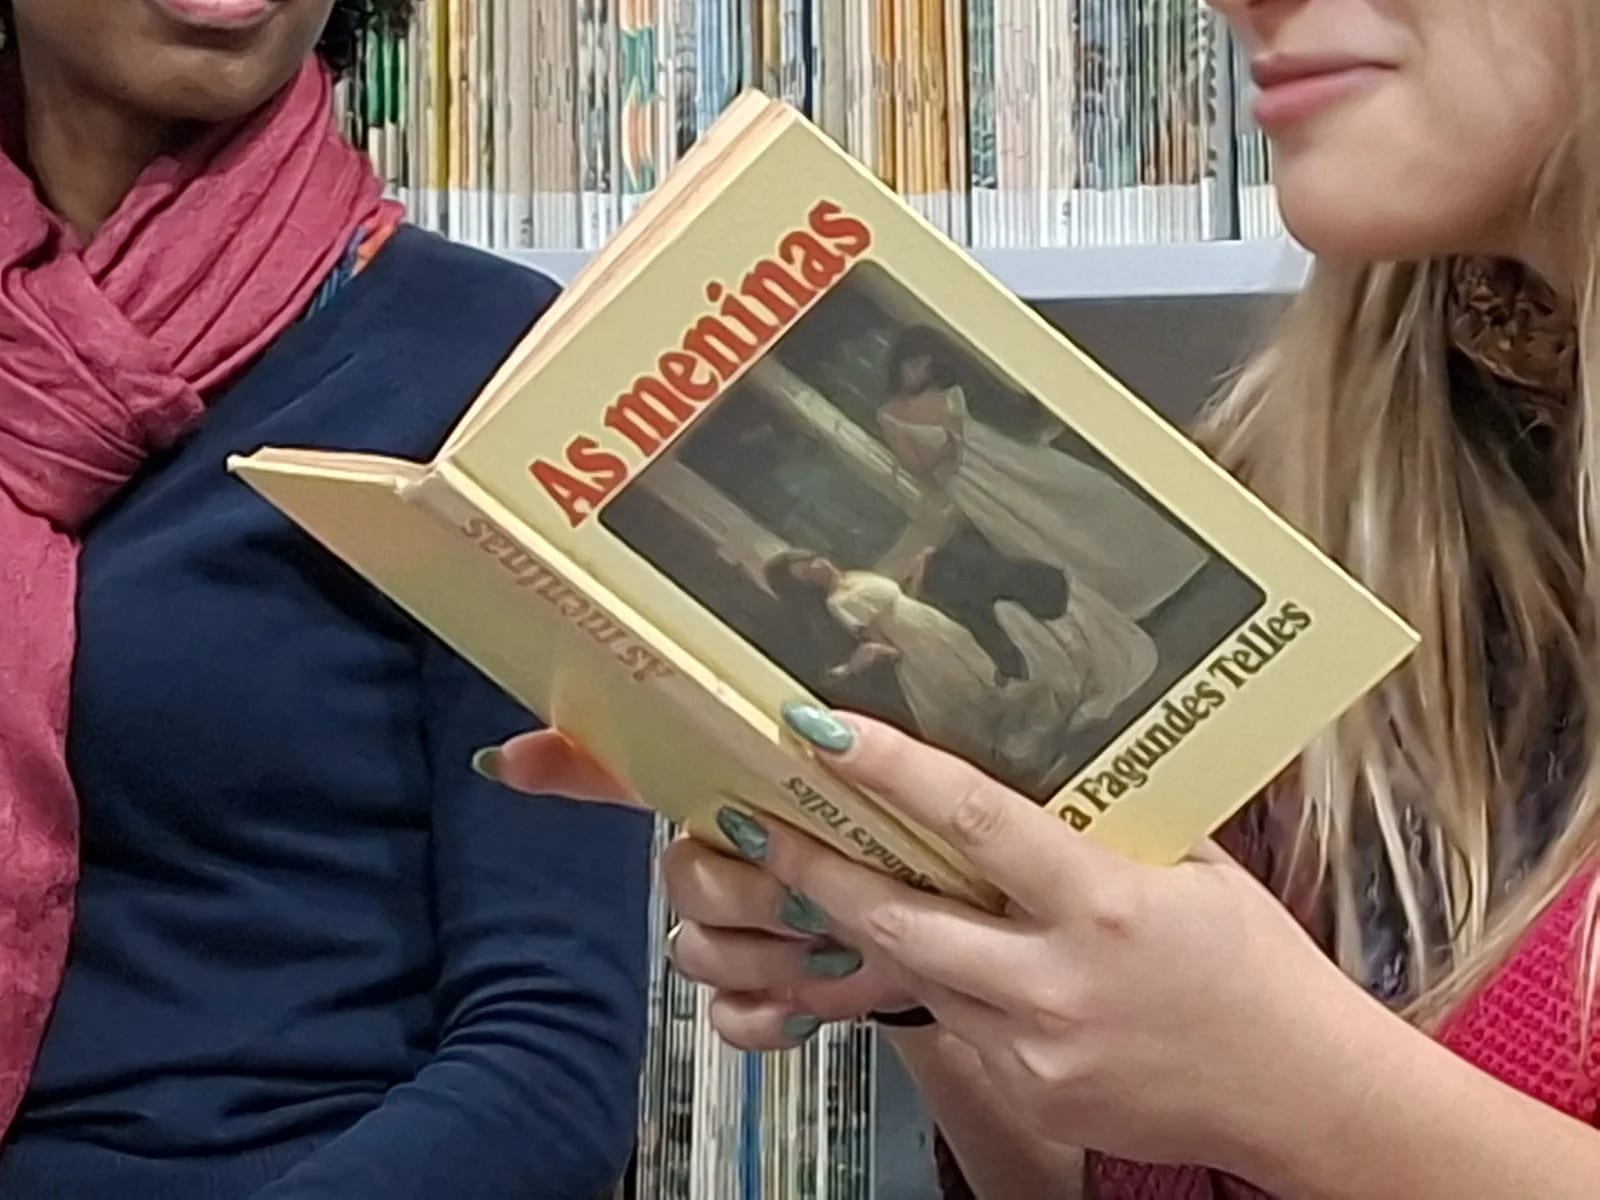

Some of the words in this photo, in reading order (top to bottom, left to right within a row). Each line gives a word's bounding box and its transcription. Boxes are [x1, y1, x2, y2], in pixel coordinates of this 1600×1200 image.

[529, 435, 628, 528] As
[604, 199, 871, 458] meninas
[461, 516, 629, 643] meninas
[617, 645, 674, 681] As
[1074, 681, 1226, 813] Fagundes
[1207, 601, 1312, 689] Telles
[781, 776, 848, 831] Telles
